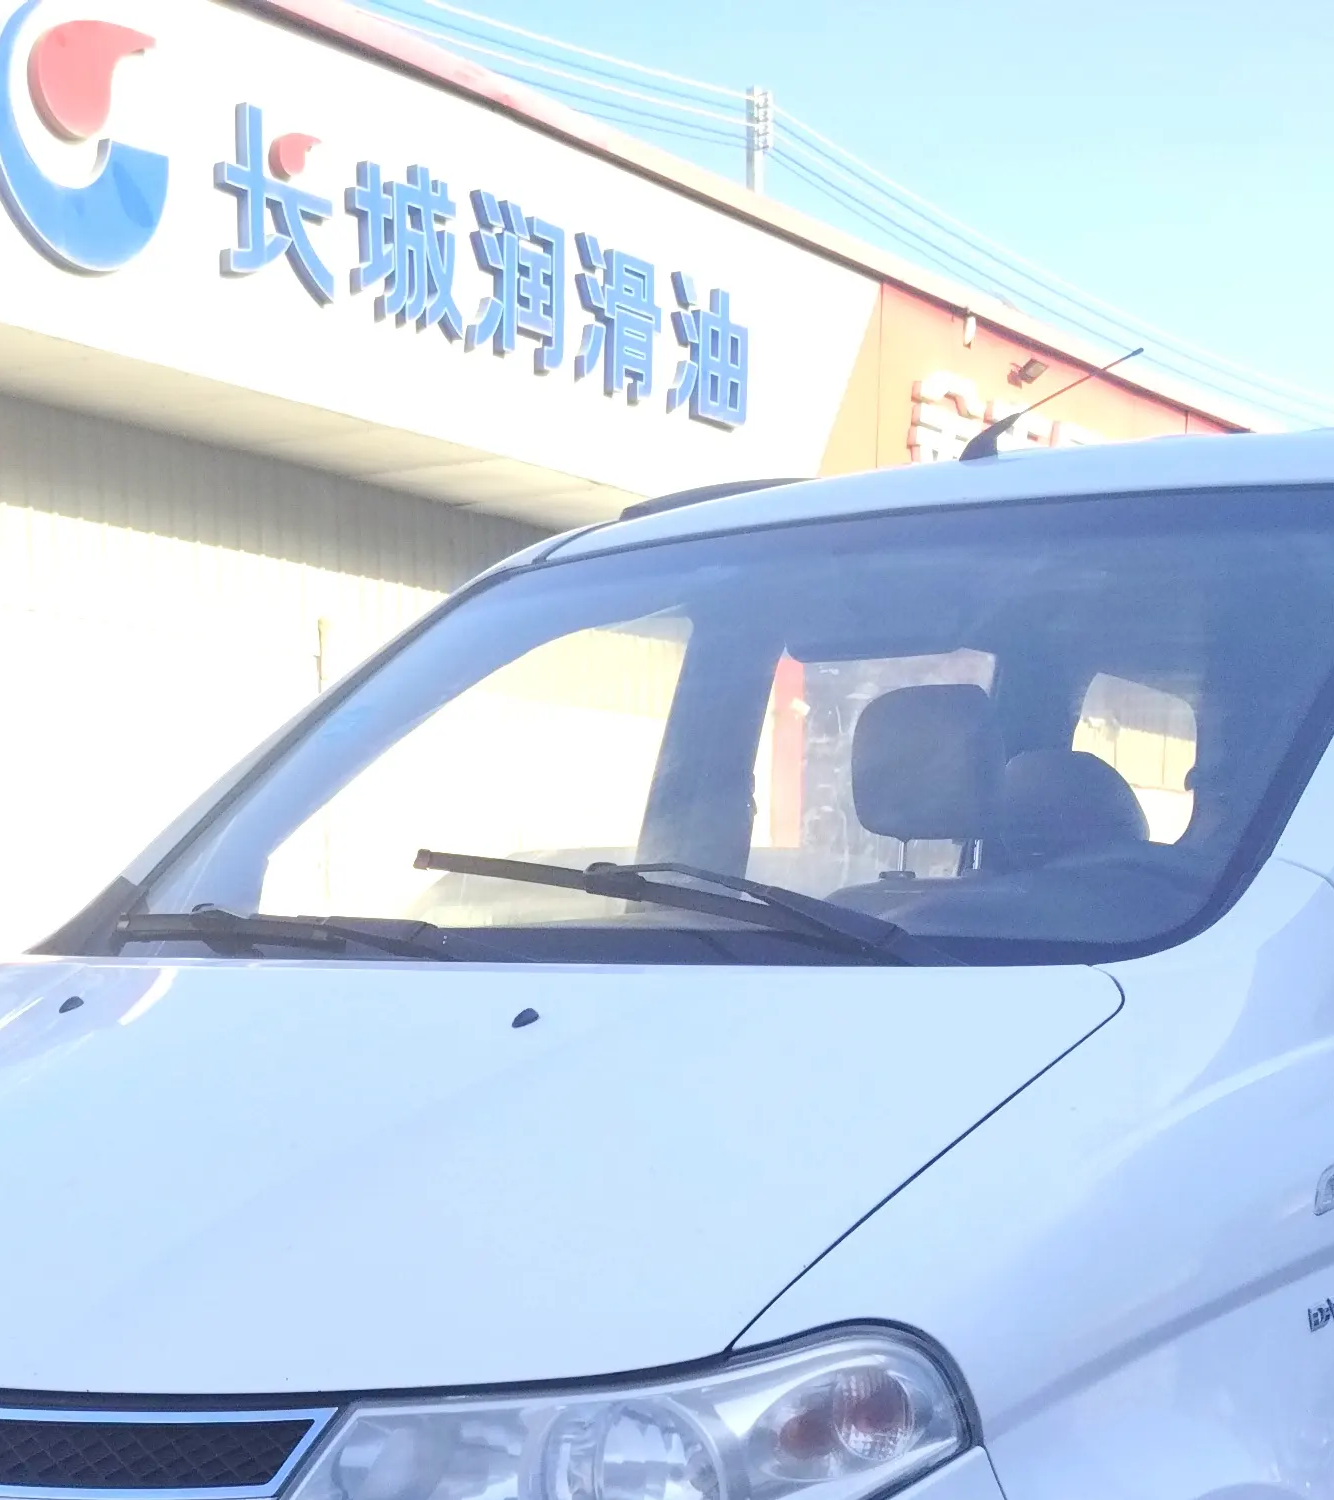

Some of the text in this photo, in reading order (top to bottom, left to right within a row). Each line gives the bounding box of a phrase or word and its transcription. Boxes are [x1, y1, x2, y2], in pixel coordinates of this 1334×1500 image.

[214, 101, 749, 433] 长城润滑油
